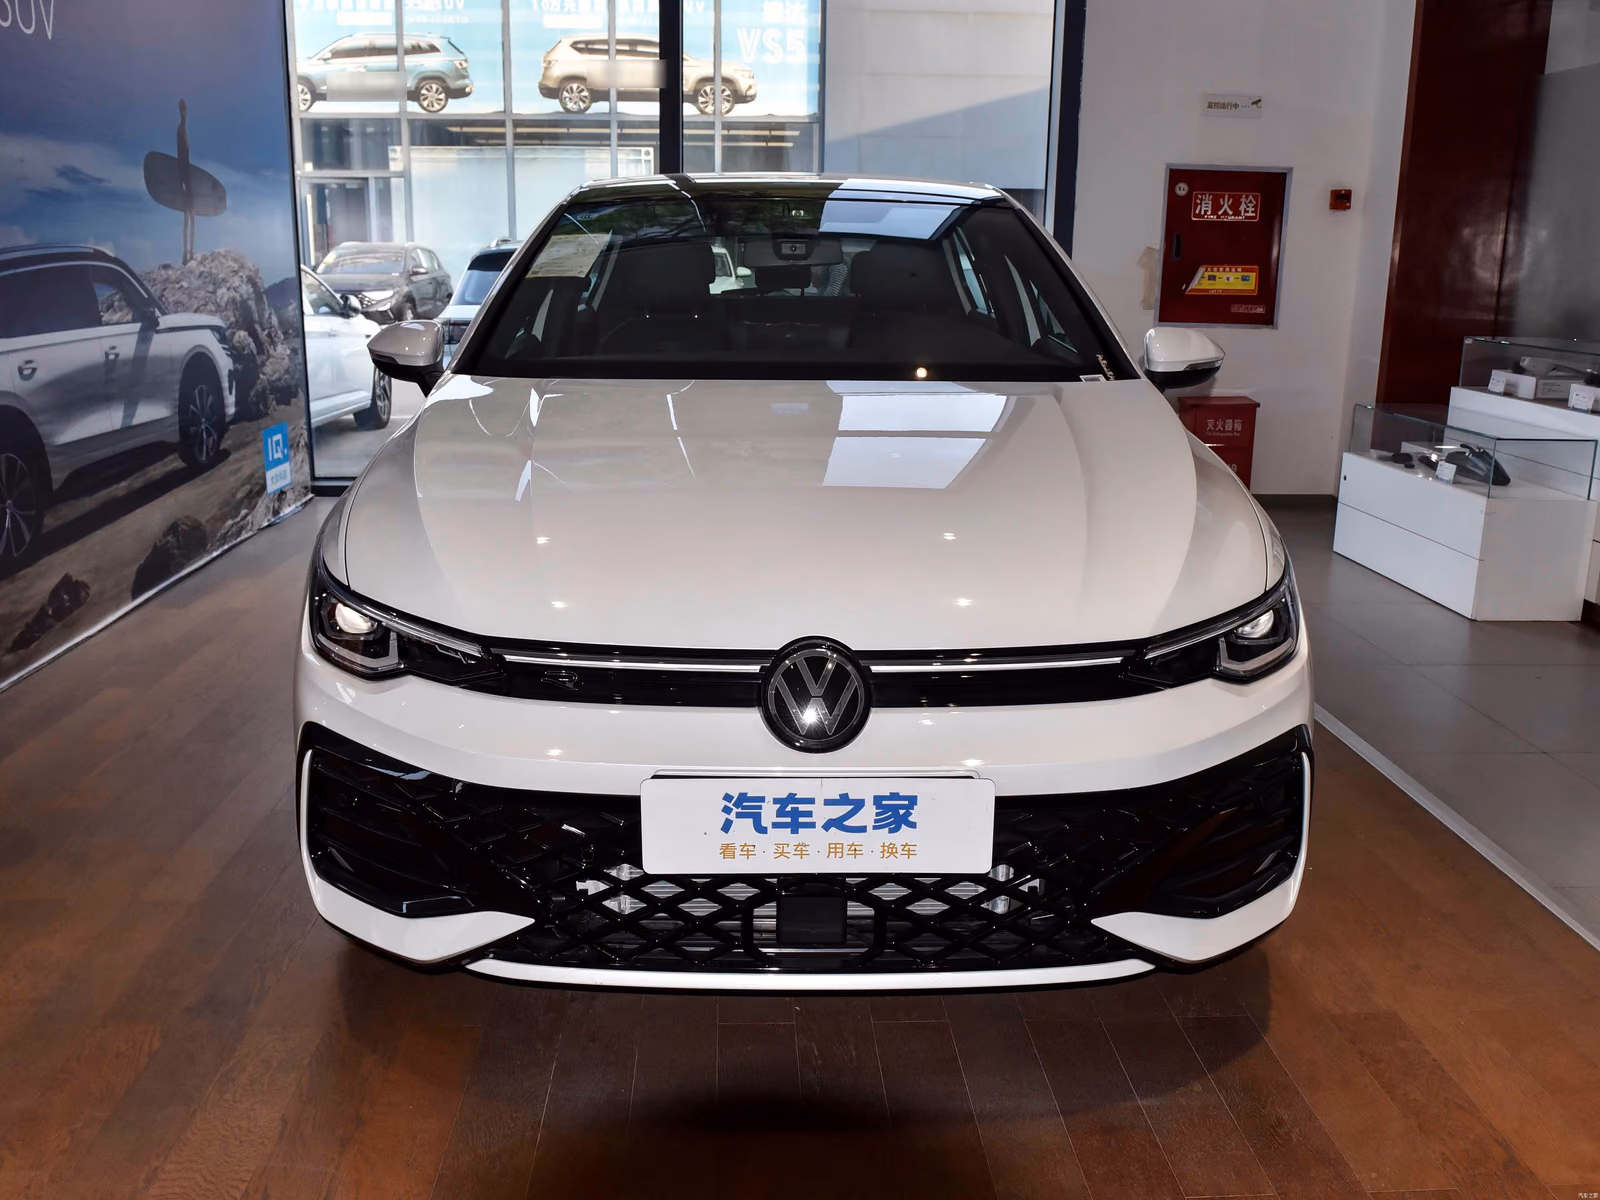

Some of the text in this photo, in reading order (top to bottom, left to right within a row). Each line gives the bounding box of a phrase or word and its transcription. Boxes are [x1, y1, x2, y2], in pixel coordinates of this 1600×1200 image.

[736, 28, 806, 65] VS5
[1195, 193, 1257, 216] 消火栓
[1206, 419, 1242, 431] 灭火器箱
[719, 792, 919, 835] 汽车之家
